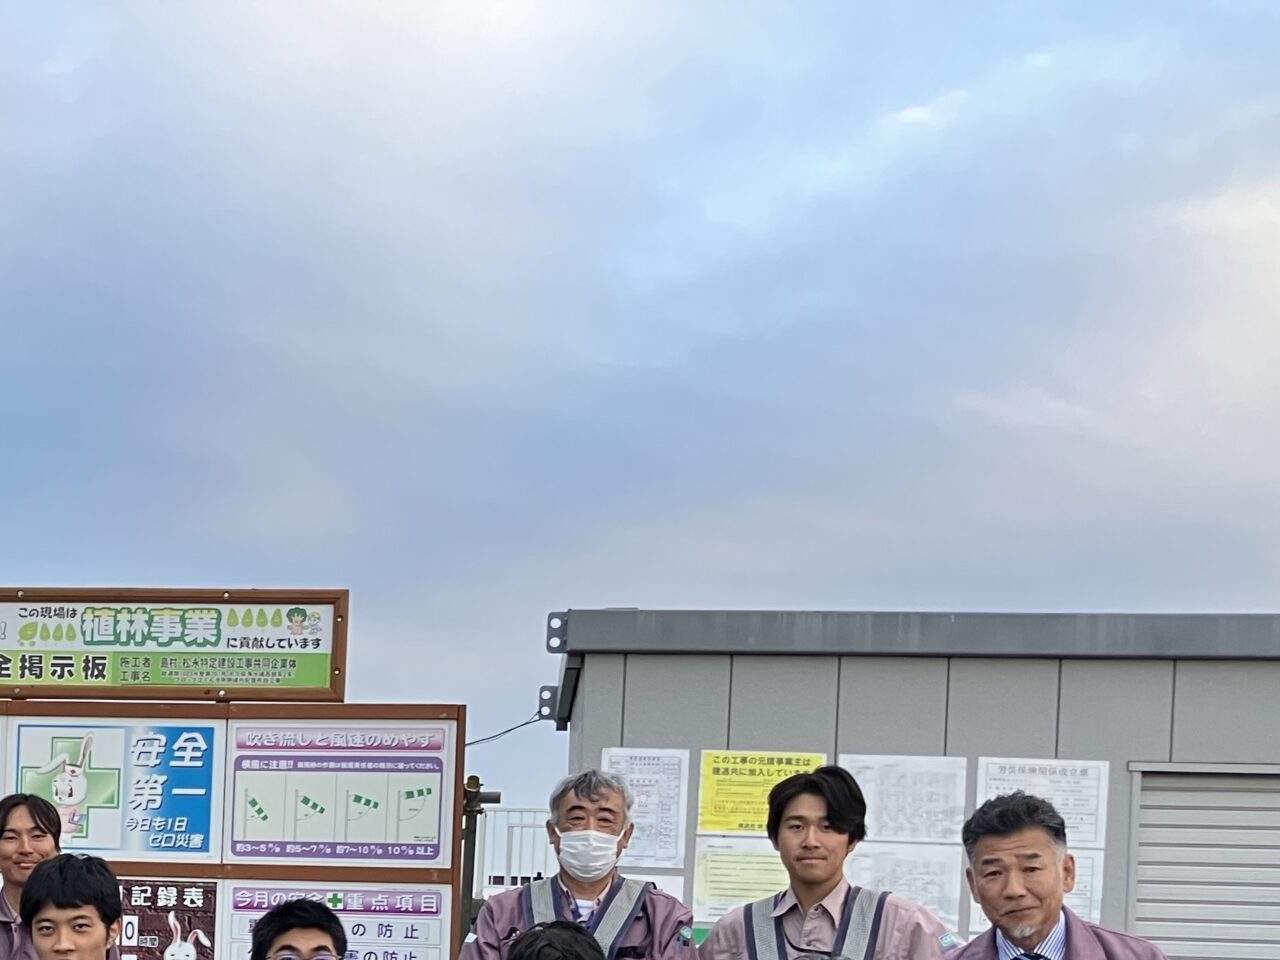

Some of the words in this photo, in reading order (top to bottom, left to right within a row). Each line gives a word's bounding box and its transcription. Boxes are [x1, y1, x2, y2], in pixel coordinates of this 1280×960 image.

[19, 606, 77, 619] この現場は
[82, 607, 221, 646] 植林事業
[227, 636, 322, 649] に貢献しています
[120, 656, 151, 668] 施工者
[120, 670, 151, 682] 工事名
[245, 732, 435, 748] 吹き流しと風速のめやす
[131, 731, 208, 767] 安全
[713, 756, 811, 766] この工事の元請事業主は
[129, 773, 206, 810] 第一
[126, 817, 188, 831] 今日も1日
[149, 833, 204, 848] ゼロ災害
[119, 885, 204, 908] 記録表
[346, 893, 438, 913] 重点項目
[125, 921, 135, 940] 0
[352, 923, 419, 939] の防止
